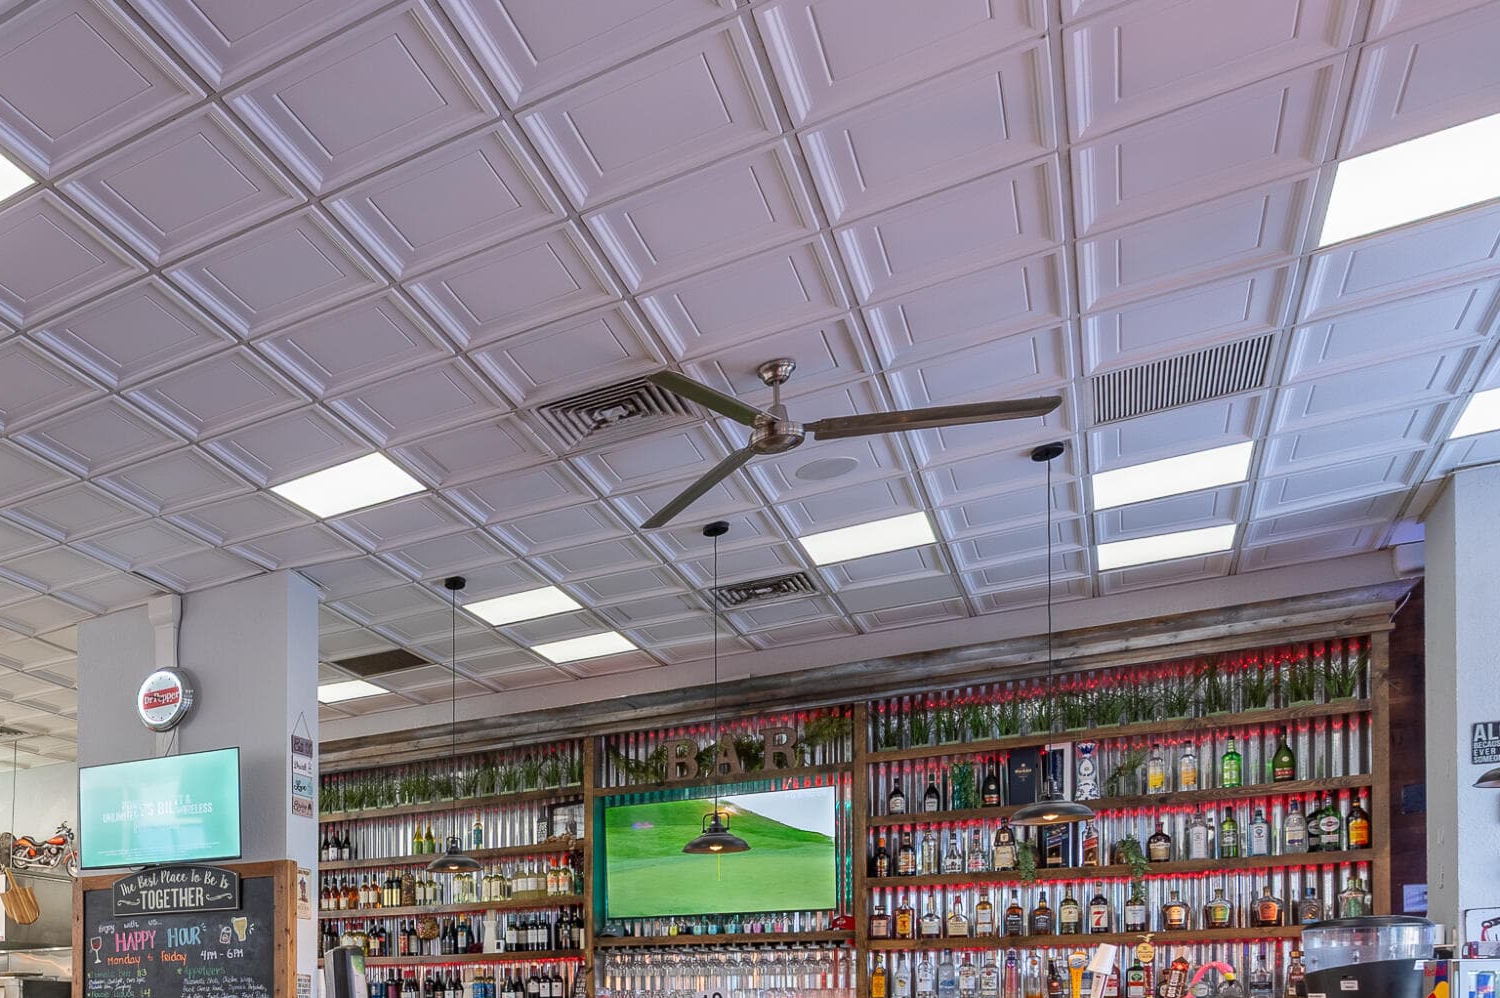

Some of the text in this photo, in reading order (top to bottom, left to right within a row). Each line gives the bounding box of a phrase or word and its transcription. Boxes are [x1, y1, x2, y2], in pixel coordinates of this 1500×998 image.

[145, 692, 180, 705] Dr Pepper
[1474, 723, 1500, 741] AL
[664, 726, 800, 782] BAR
[1474, 747, 1496, 756] EVER
[120, 869, 230, 896] The Best Place To Be Is
[140, 887, 204, 910] TOGETHER
[1092, 911, 1107, 927] 7
[115, 926, 201, 952] HAPPY HOUR
[107, 953, 141, 966] Monday
[161, 951, 187, 965] Friday
[201, 950, 217, 960] 4PM
[227, 948, 244, 959] 6PM
